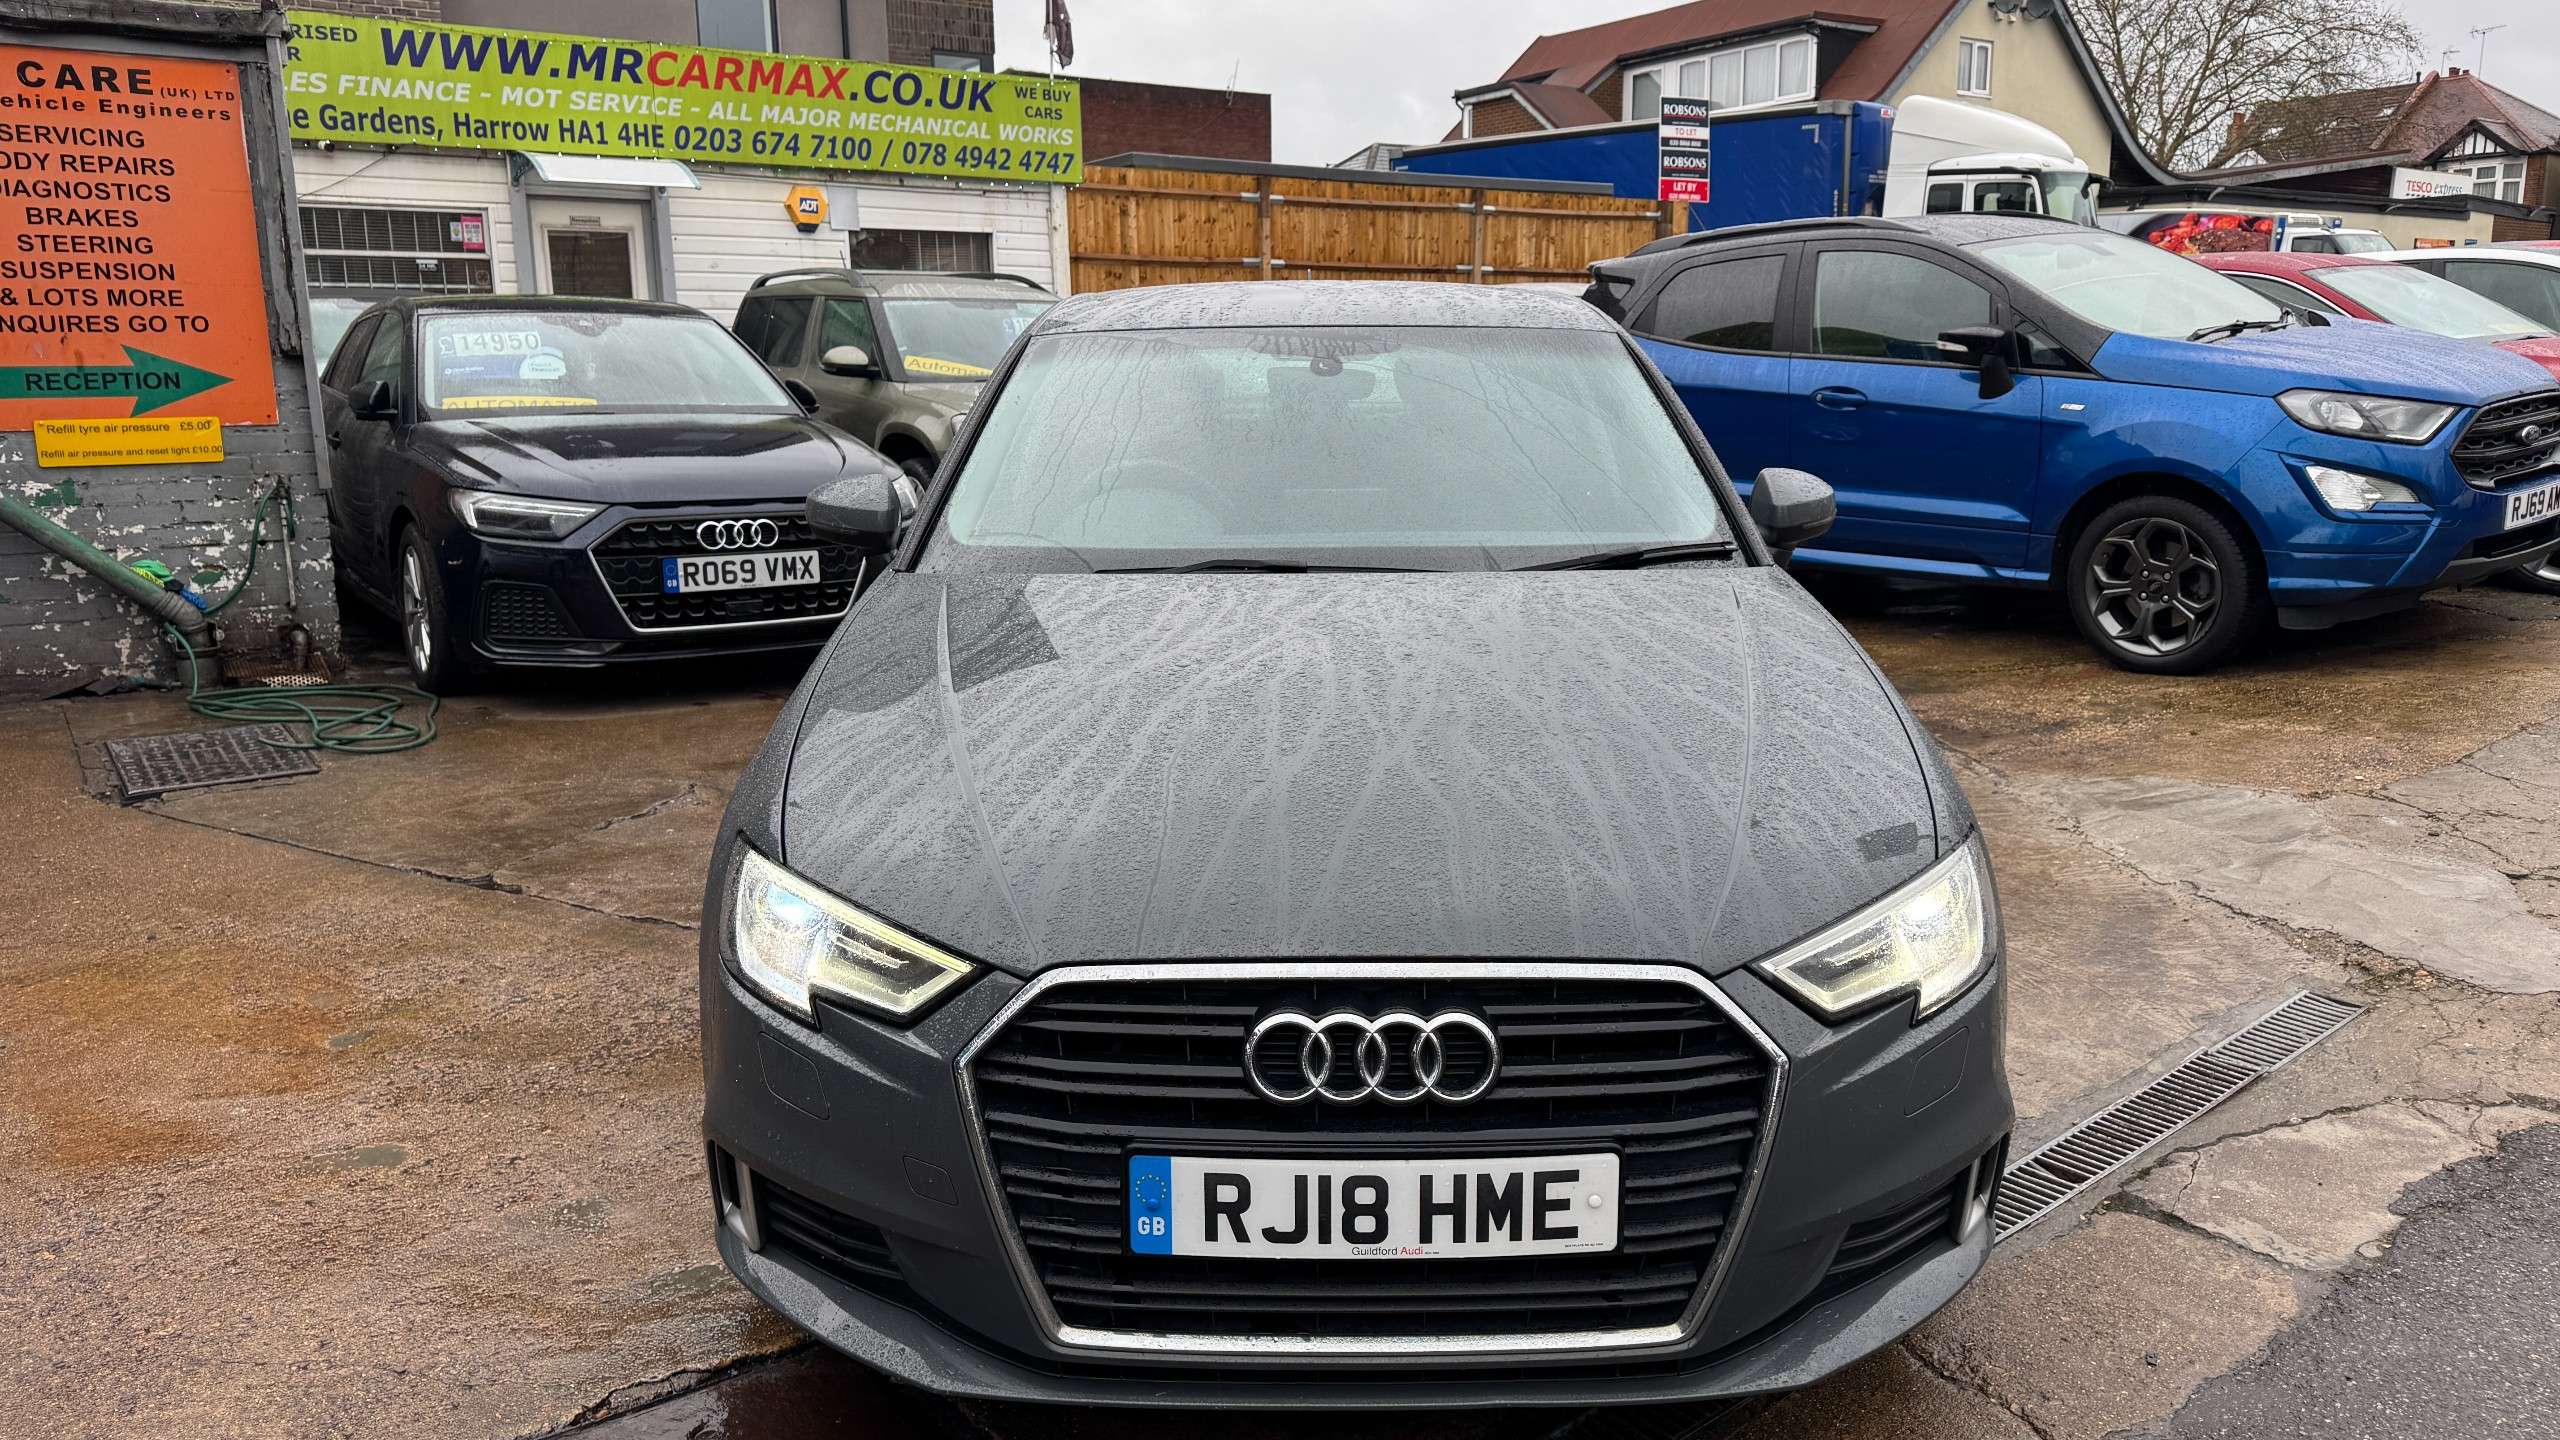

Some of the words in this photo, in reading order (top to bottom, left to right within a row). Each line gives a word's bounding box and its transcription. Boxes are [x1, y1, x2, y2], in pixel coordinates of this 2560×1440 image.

[289, 24, 358, 42] RISED
[381, 28, 996, 112] WWW.MRCARMAX.CO.UK
[16, 60, 153, 95] CARE
[160, 87, 197, 101] (UK)
[204, 90, 235, 101] LTD
[1015, 86, 1037, 100] WE
[1043, 89, 1072, 103] BUY
[100, 98, 231, 120] Engineers
[284, 71, 327, 93] ES
[338, 75, 471, 102] FINANCE
[501, 86, 562, 110] MOT
[569, 90, 682, 116] SERVICE
[708, 101, 752, 121] ALL
[761, 104, 841, 129] MAJOR
[848, 111, 990, 139] MECHANICAL
[1000, 124, 1073, 146] WORKS
[1025, 106, 1063, 120] CARS
[1663, 104, 1707, 118] ROBSONS
[0, 123, 145, 148] SERVICING
[319, 103, 443, 142] Gardens,
[453, 112, 549, 142] Harrow
[559, 119, 608, 145] HA1
[617, 123, 664, 148] 4HE
[675, 125, 742, 151] 0203
[752, 131, 800, 157] 674
[810, 133, 872, 161] 7100
[880, 138, 894, 167] /
[903, 141, 947, 167] 078
[955, 145, 1011, 171] 4942
[1018, 149, 1075, 175] 4747
[60, 154, 175, 176] REPAIRS
[1663, 156, 1707, 169] ROBSONS
[0, 179, 171, 202] IAGNOSTICS
[1673, 181, 1687, 192] LET
[2407, 180, 2433, 193] TESCO
[2433, 184, 2463, 196] express
[800, 199, 818, 212] ADT
[26, 207, 139, 228] BRAKES
[17, 234, 153, 255] STEERING
[1, 260, 175, 281] SUSPENSION
[0, 288, 18, 306] &
[27, 288, 98, 306] LOTS
[107, 289, 184, 307] MORE
[128, 315, 167, 333] GO
[174, 316, 209, 333] TO
[25, 372, 181, 391] RECEPTION
[46, 424, 76, 434] Refill
[79, 424, 100, 436] tyre
[104, 423, 117, 433] air
[121, 422, 170, 436] pressure
[179, 420, 211, 431] £5.00
[40, 449, 65, 459] Refill
[68, 449, 79, 458] air
[82, 447, 124, 460] pressure
[126, 446, 143, 456] and
[171, 444, 190, 457] light
[2512, 489, 2546, 522] RJ69
[682, 559, 756, 587] RO69
[764, 555, 815, 582] VMX
[1203, 1172, 1389, 1244] RJ18
[1419, 1169, 1580, 1243] HME
[1137, 1216, 1166, 1236] GB
[1351, 1246, 1398, 1256] Guildford
[1401, 1246, 1424, 1256] Audi
